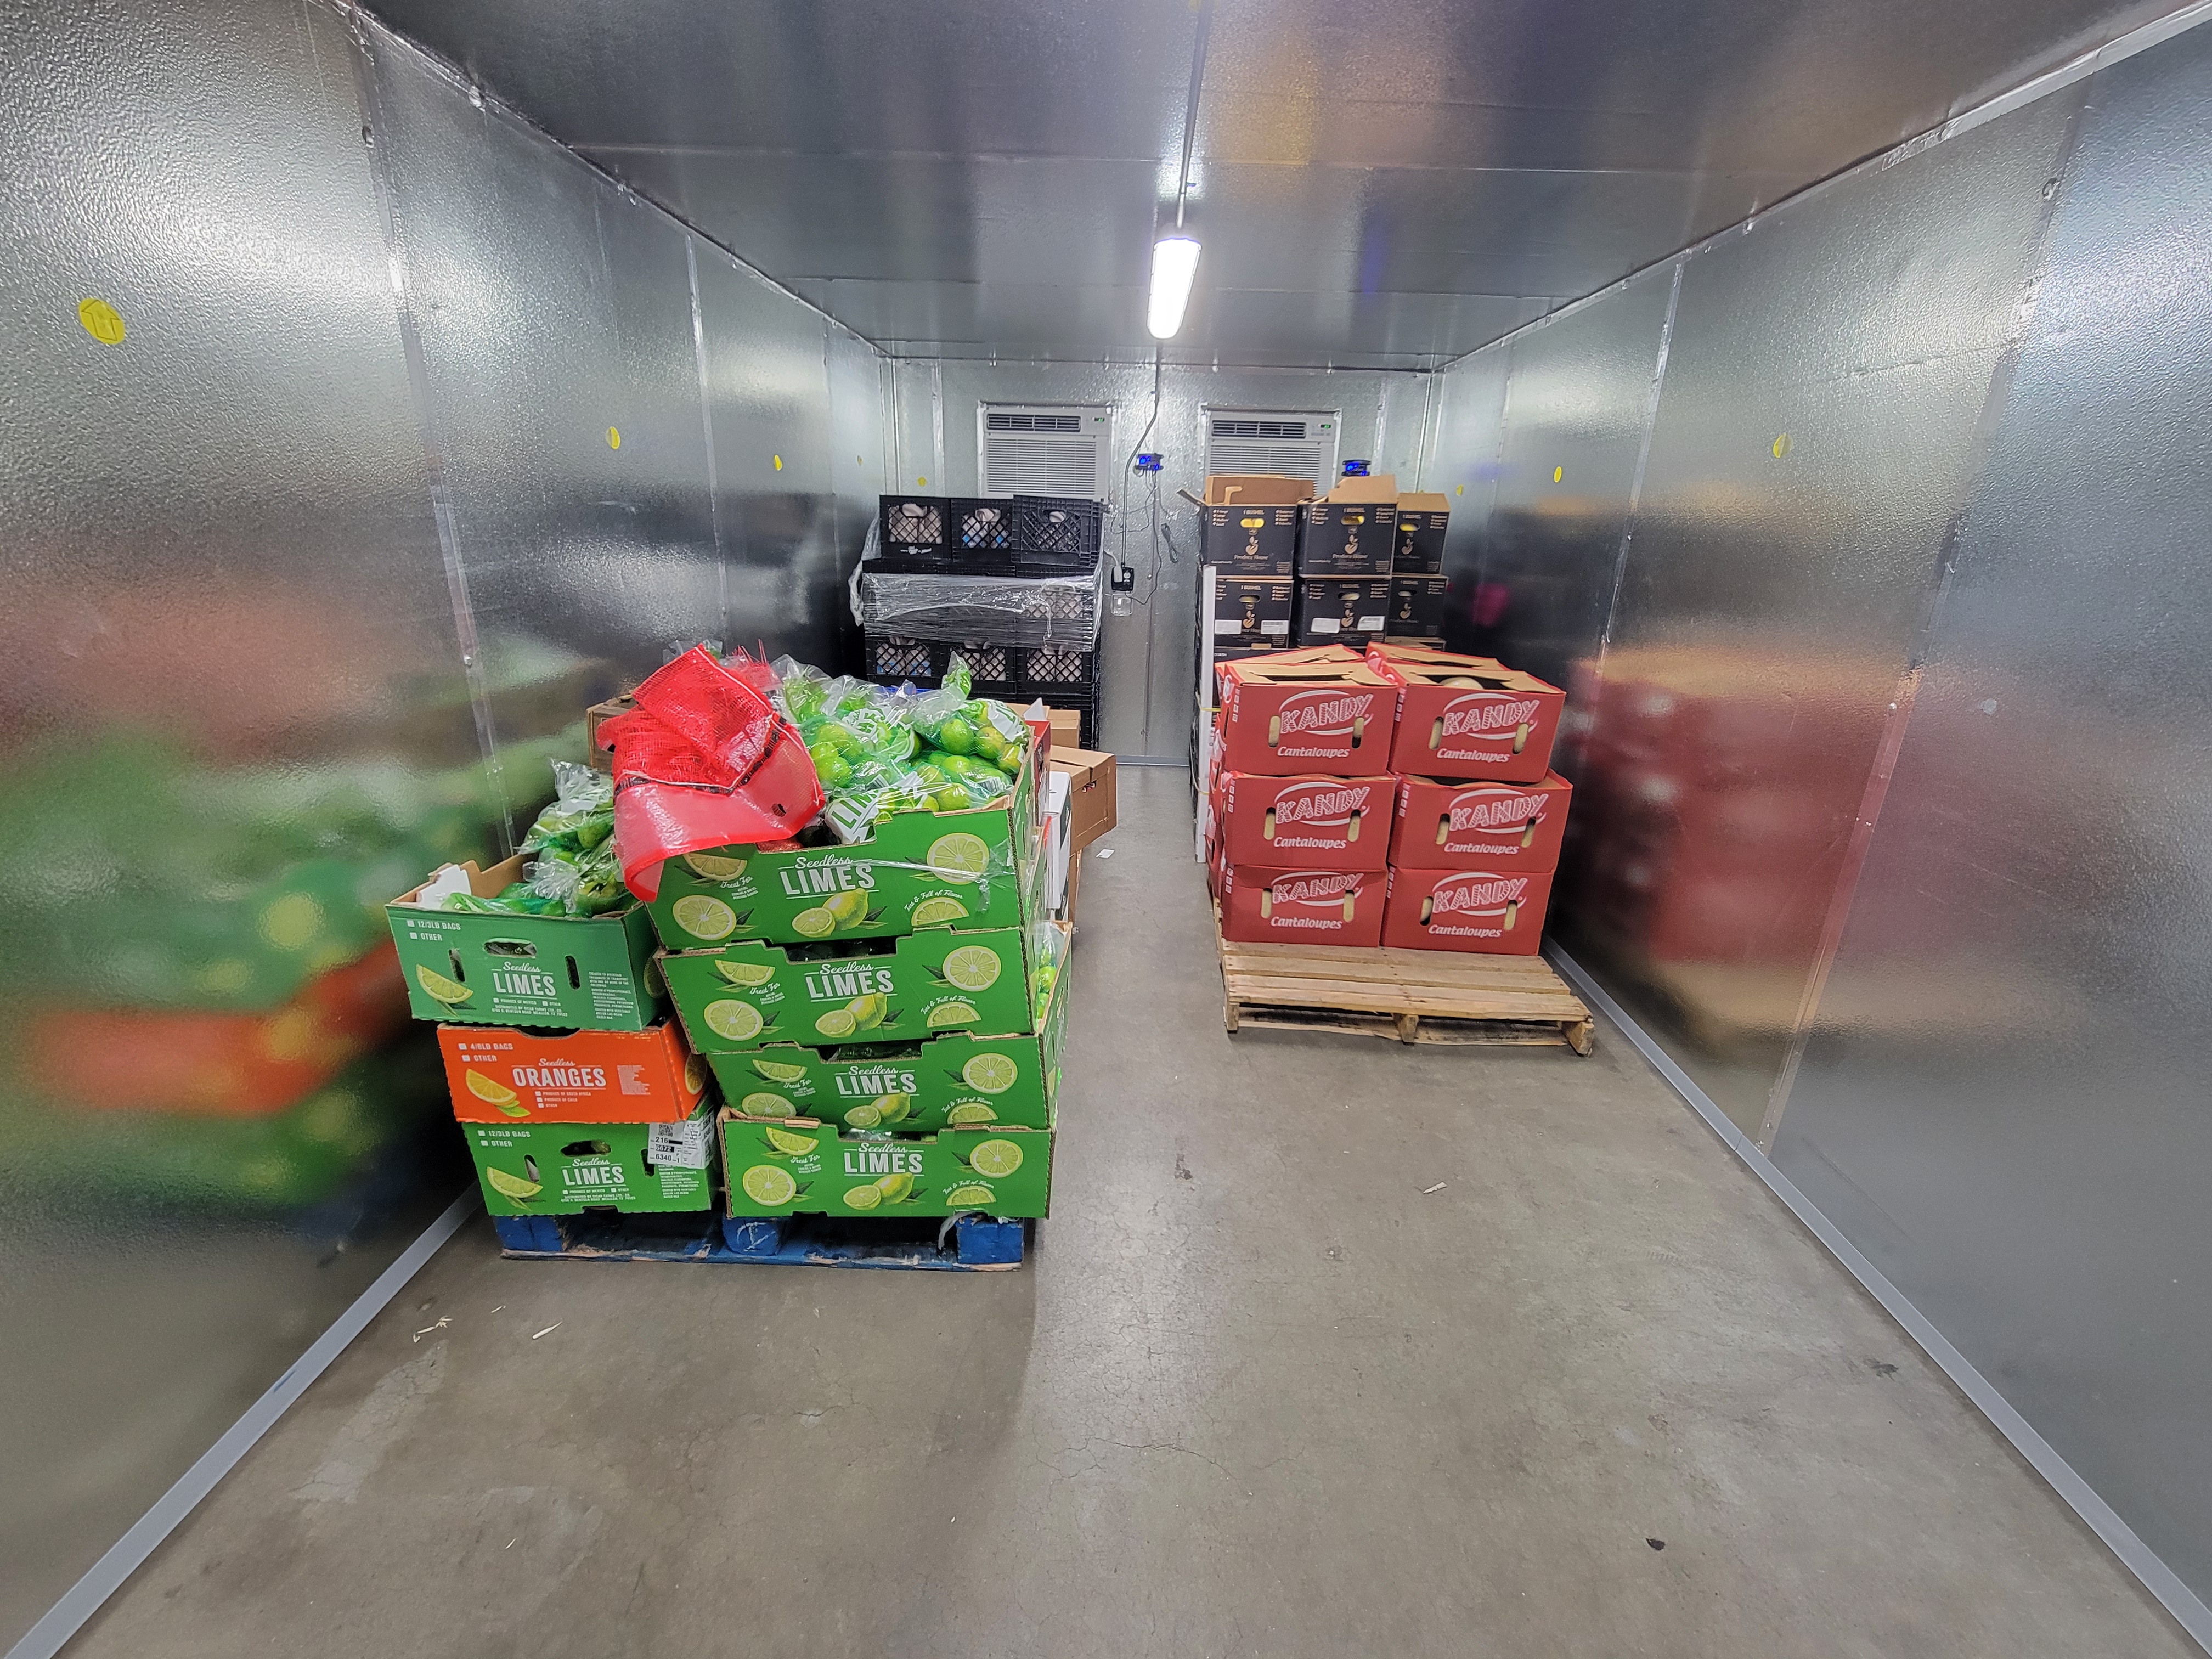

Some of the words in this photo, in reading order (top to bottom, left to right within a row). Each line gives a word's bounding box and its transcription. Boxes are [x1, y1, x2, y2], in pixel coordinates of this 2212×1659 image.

[1280, 693, 1374, 734] KANDY
[1442, 699, 1540, 736] KANDY
[1278, 746, 1350, 758] Cantaloupes
[1437, 748, 1510, 763] Cantaloupes
[831, 790, 878, 830] LIM
[1276, 786, 1370, 824] KANDY
[1449, 793, 1549, 831] KANDY
[1274, 836, 1347, 849] Cantaloupes
[1444, 842, 1519, 855] Cantaloupes
[794, 854, 853, 869] Seedless
[739, 876, 753, 885] For
[780, 864, 875, 895] LIMES
[921, 890, 934, 899] Full
[1272, 873, 1364, 904] KANDY
[1432, 878, 1528, 913] KANDY
[1271, 916, 1342, 930] Cantaloupes
[420, 933, 443, 941] OTHER
[1428, 924, 1502, 938] Cantaloupes
[503, 961, 541, 972] Seedless
[820, 961, 874, 975] Seedless
[493, 973, 556, 996] LIMES
[805, 970, 894, 998] LIMES
[538, 1058, 575, 1066] Seedless
[848, 1064, 899, 1075] Seedless
[512, 1068, 606, 1087] ORANGES
[836, 1074, 917, 1095] LIMES
[858, 1143, 908, 1153] Seedless
[572, 1158, 611, 1167] Seedless
[844, 1152, 923, 1173] LIMES
[562, 1166, 625, 1186] LIMES
